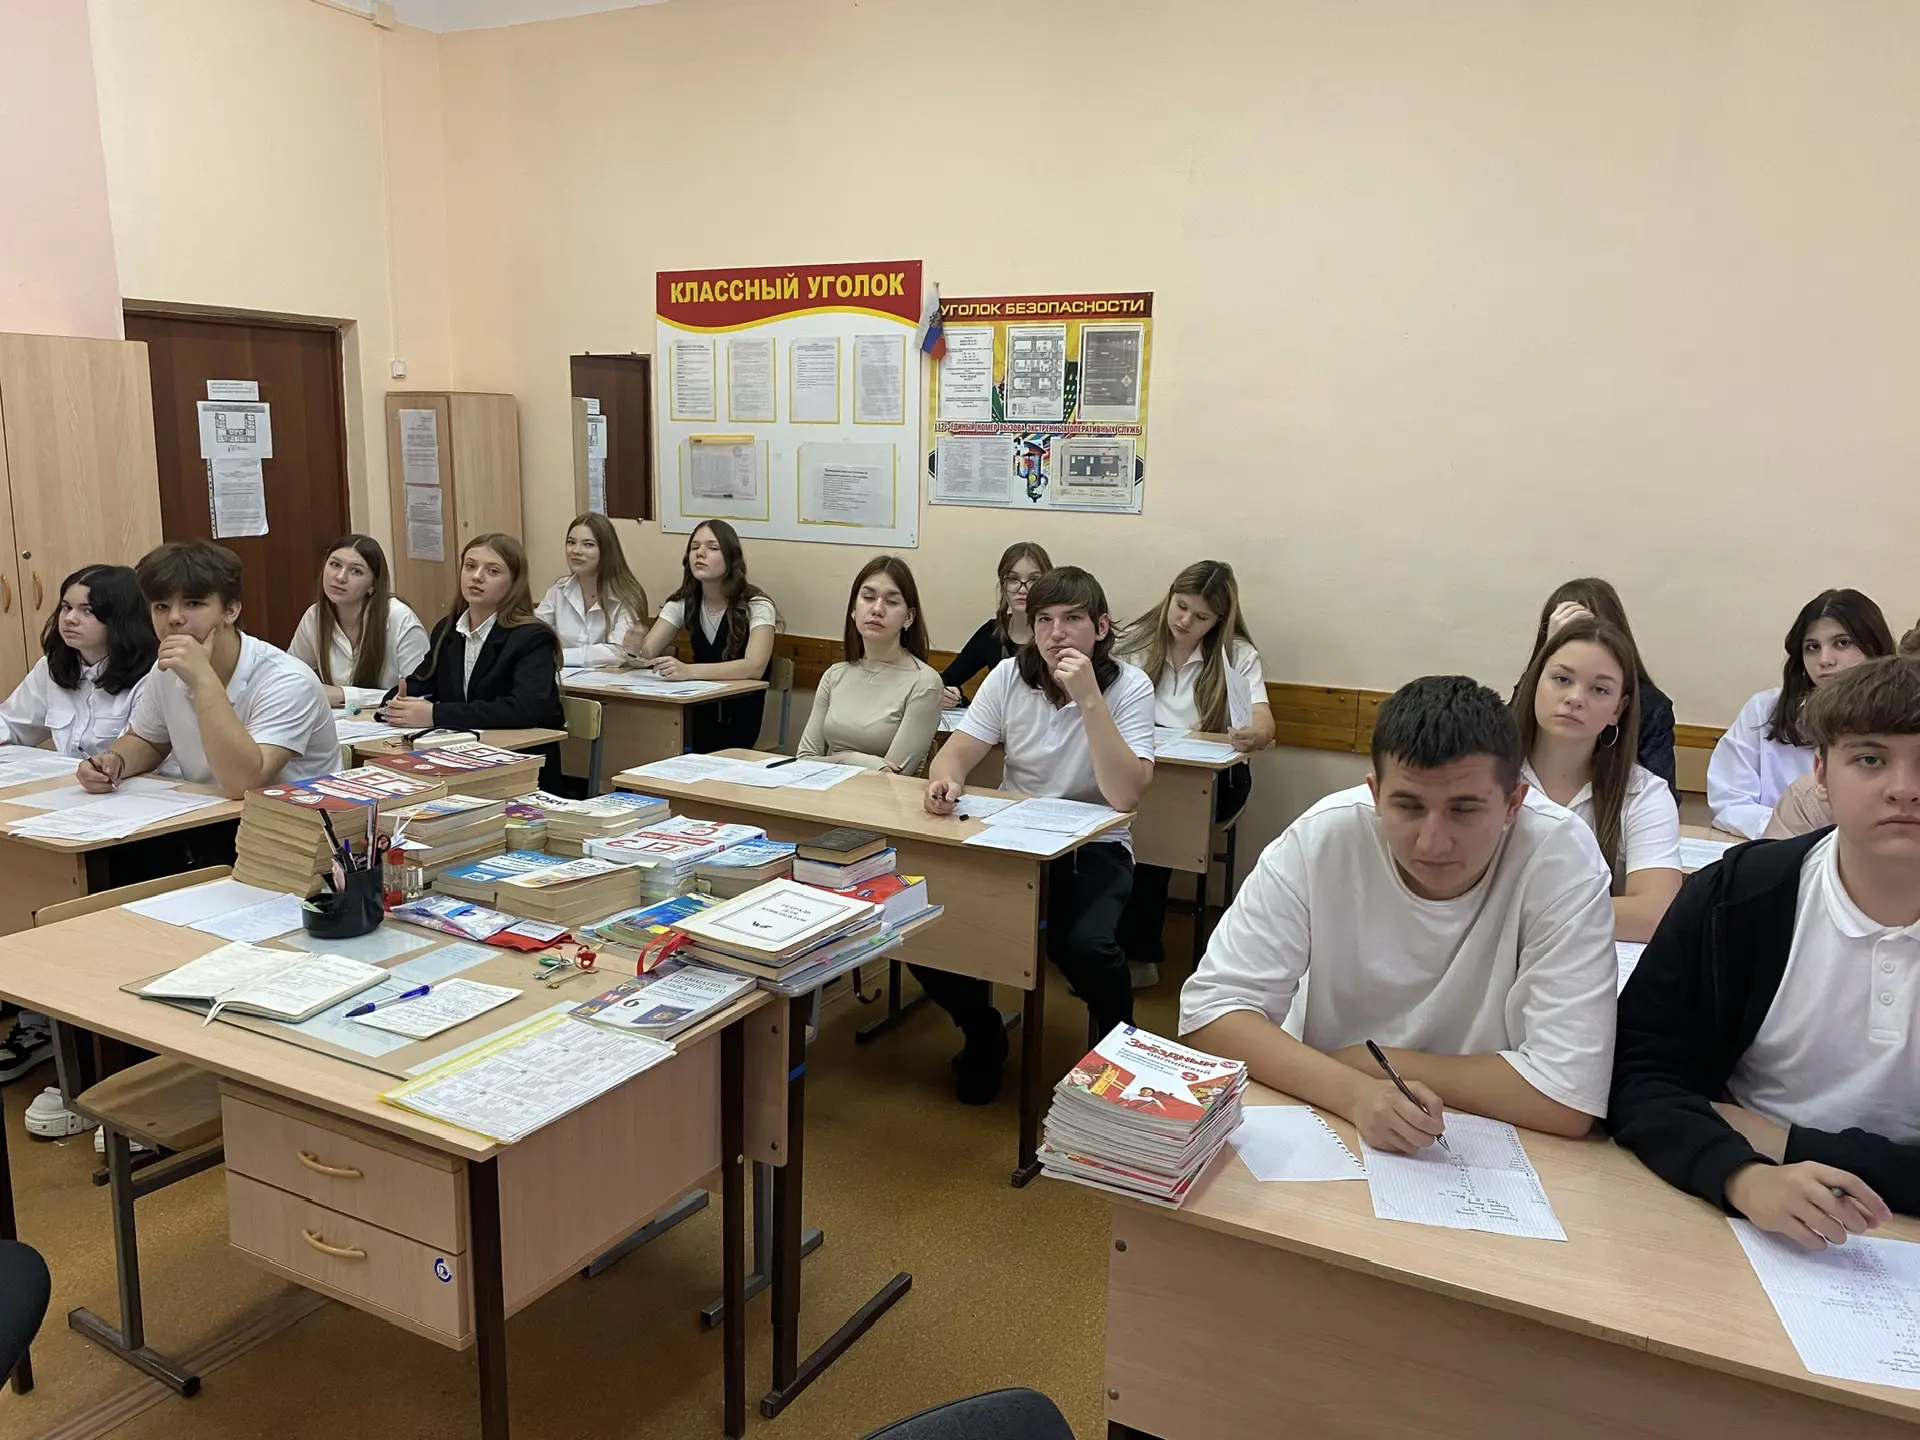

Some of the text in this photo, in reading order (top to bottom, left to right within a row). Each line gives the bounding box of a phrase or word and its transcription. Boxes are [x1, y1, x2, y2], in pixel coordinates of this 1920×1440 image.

[670, 272, 905, 303] КЛАССНЫЙ УГОЛОК
[940, 299, 1145, 317] УГОЛОК БЕЗОПАСНОСТИ
[976, 422, 998, 432] НОМЕР
[999, 423, 1025, 432] ВЫЗОВА
[1026, 424, 1068, 433] ЭКСТРЕННЫХ
[1069, 425, 1116, 434] ОПЕРАТИВНЫХ
[1117, 425, 1141, 434] СЛУЖБ
[1146, 1052, 1212, 1076] английский
[1180, 1071, 1200, 1082] 9
